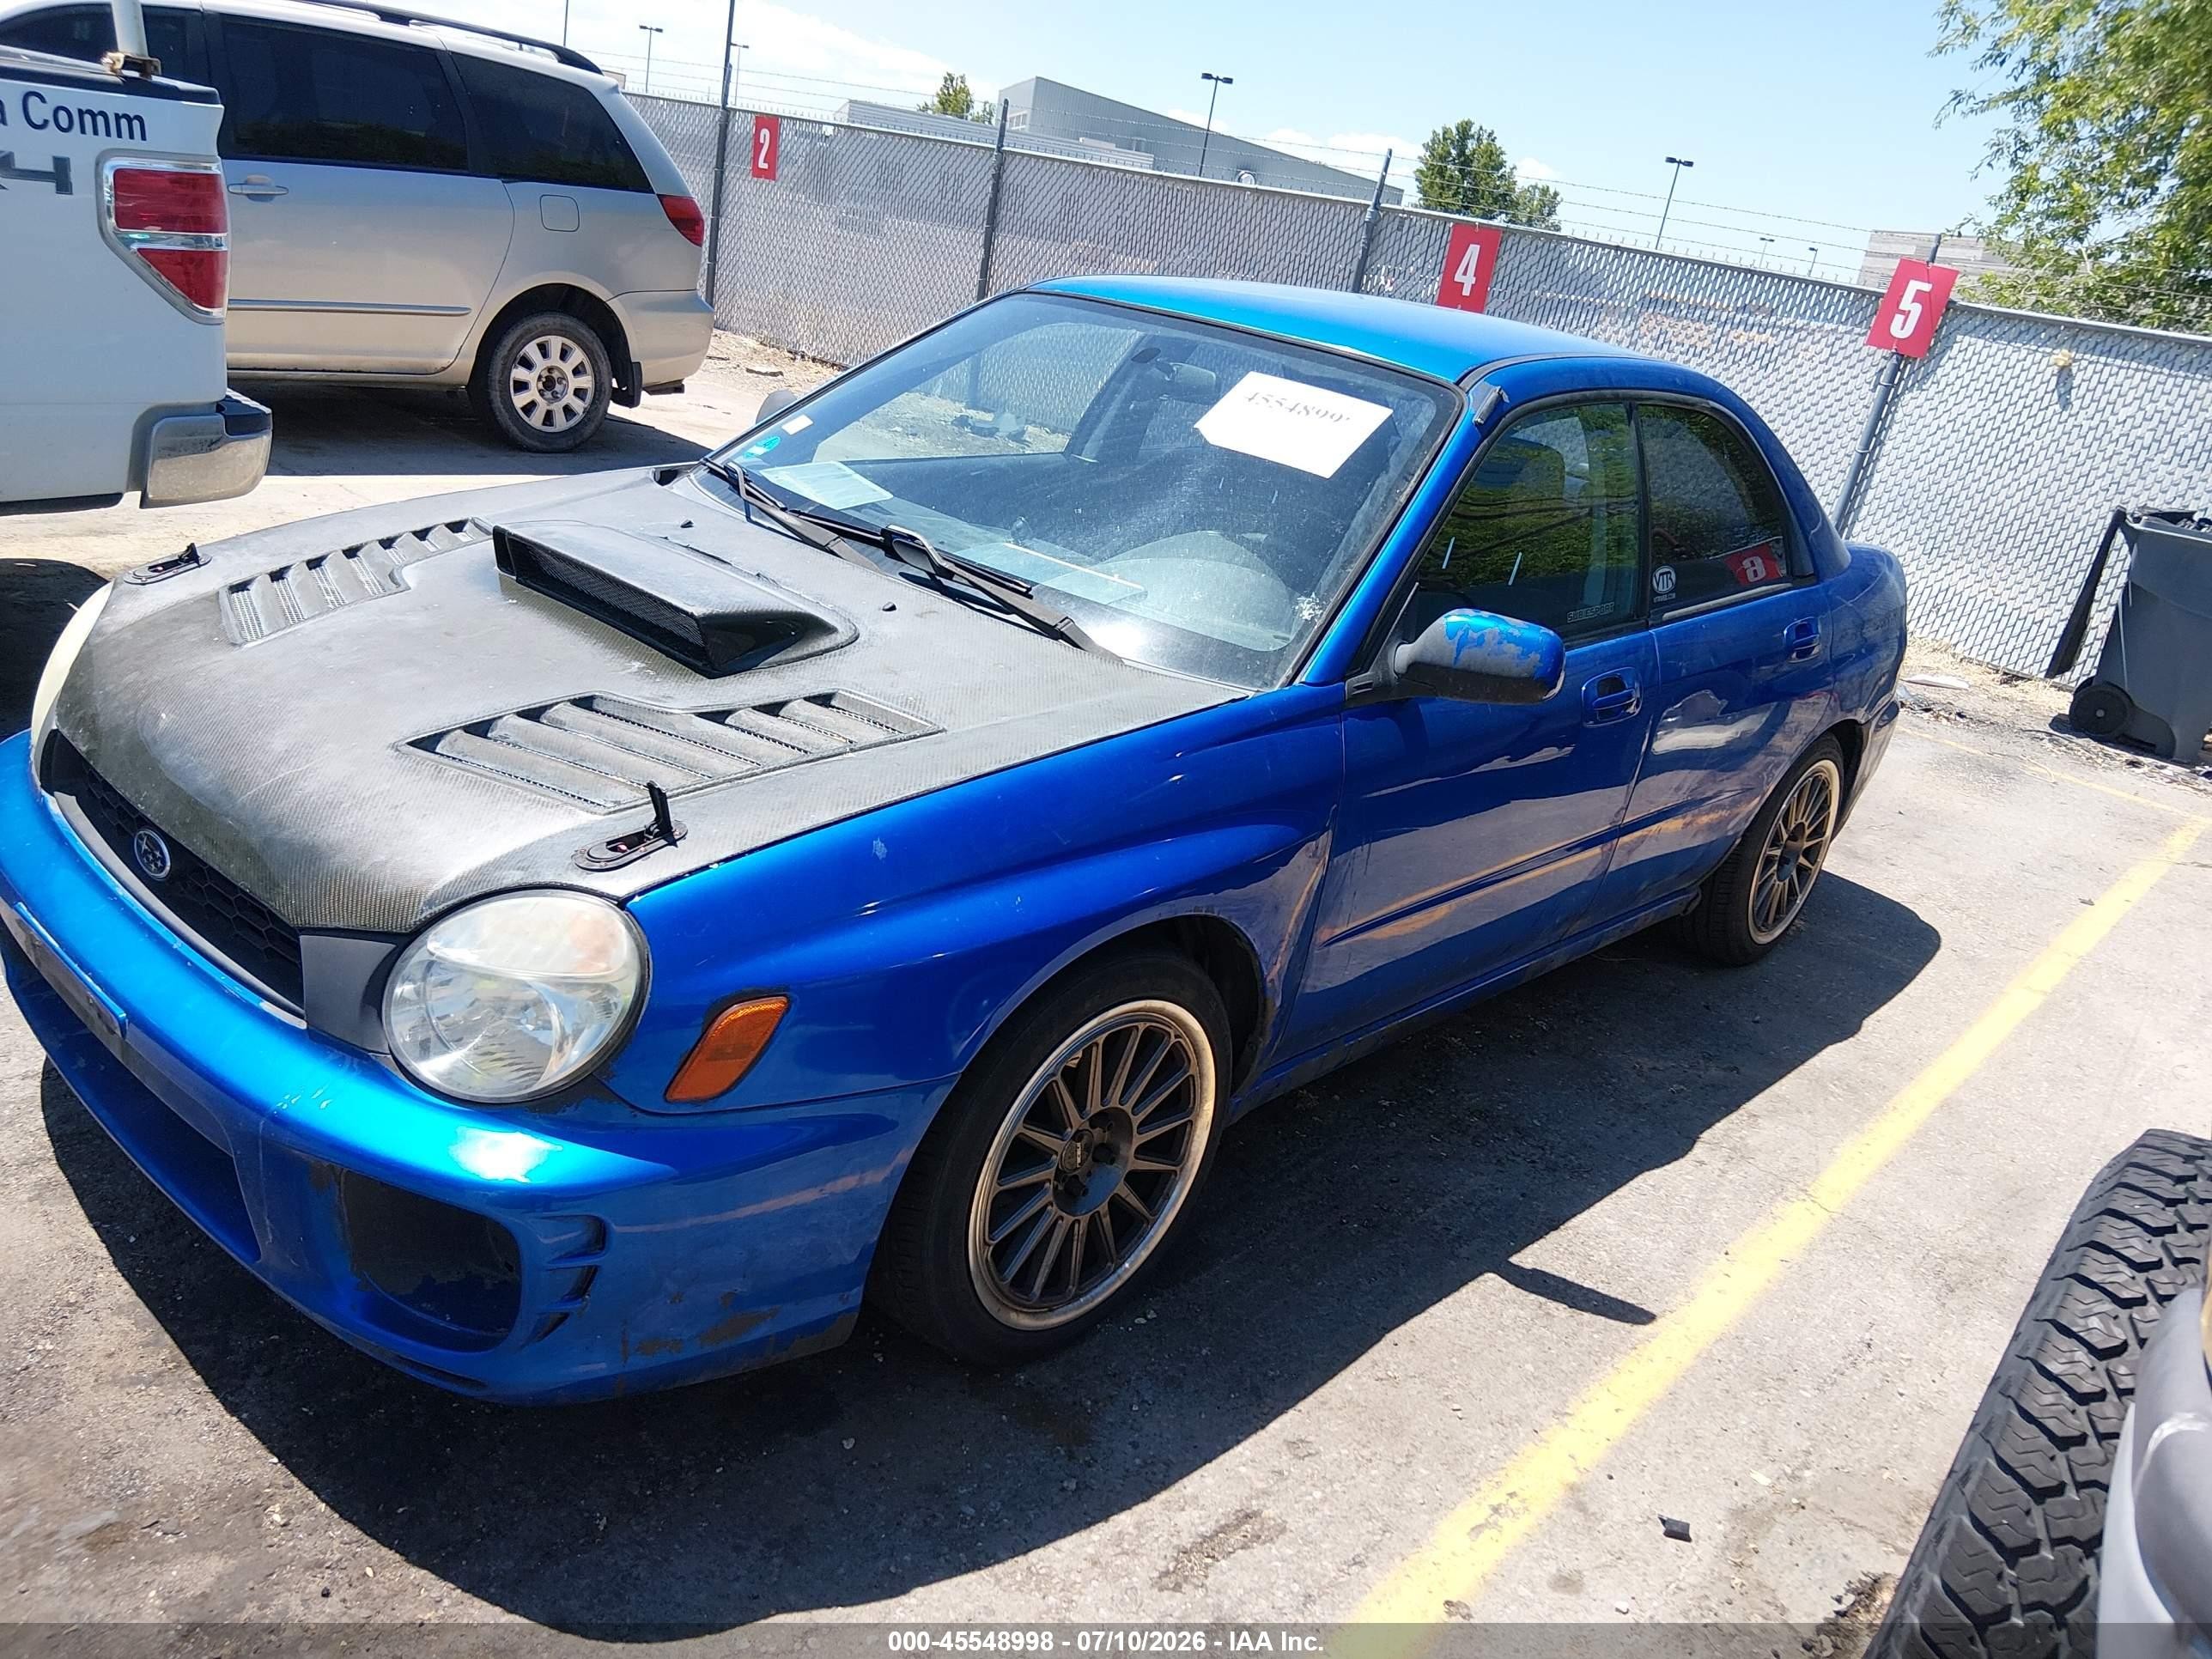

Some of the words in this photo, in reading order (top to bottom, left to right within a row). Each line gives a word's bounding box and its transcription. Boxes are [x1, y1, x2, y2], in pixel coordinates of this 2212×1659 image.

[21, 90, 148, 142] Comm
[758, 127, 771, 170] 2
[1454, 243, 1481, 296] 4
[1889, 278, 1934, 339] 5
